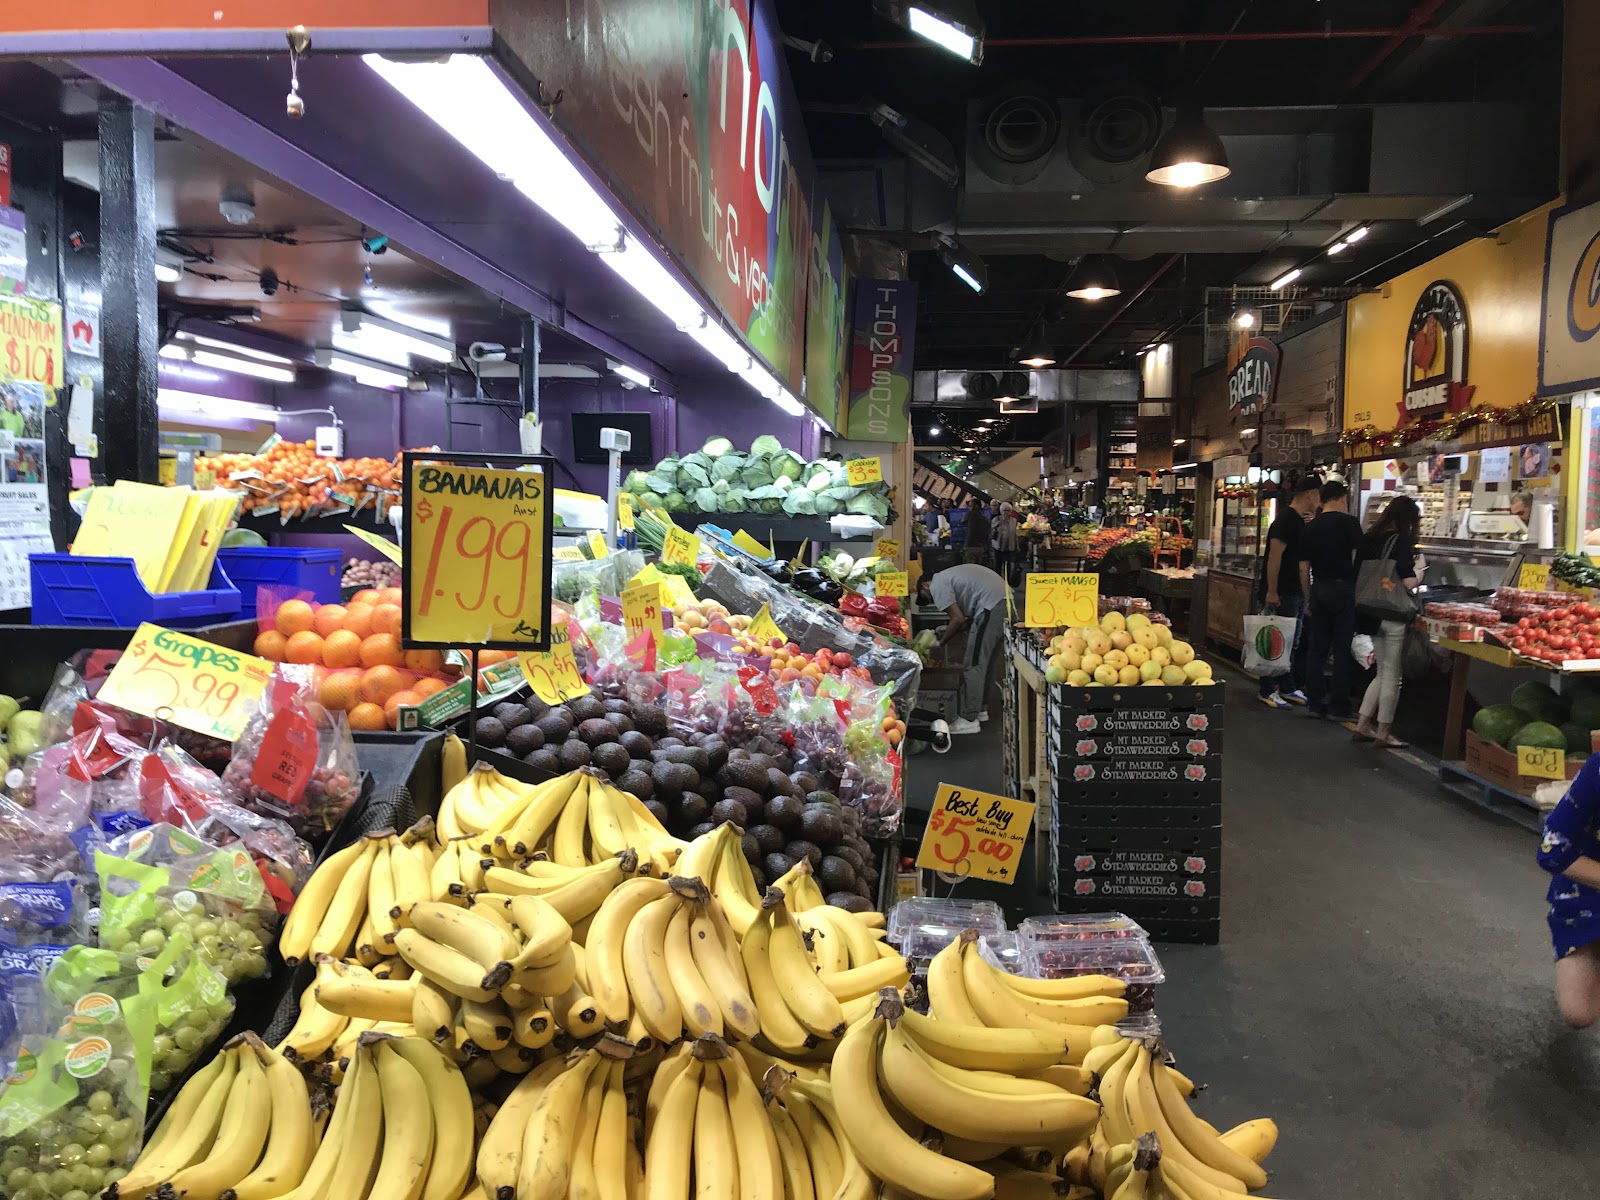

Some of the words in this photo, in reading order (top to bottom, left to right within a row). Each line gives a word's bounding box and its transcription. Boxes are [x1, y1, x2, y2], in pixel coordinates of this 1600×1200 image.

[679, 116, 722, 263] fruit
[868, 287, 898, 435] THOMPSONS
[1229, 358, 1271, 410] BREAD
[1405, 382, 1448, 411] CUISINE
[1266, 432, 1311, 449] STALL
[418, 467, 541, 501] BANANAS
[415, 497, 531, 619] $1.99
[1028, 576, 1058, 586] Sweet
[1060, 576, 1098, 586] MANGO
[1031, 587, 1056, 625] 3
[153, 630, 241, 673] Grapes
[1104, 716, 1180, 730] STRAWBERRIES
[1118, 711, 1129, 720] MT
[1132, 711, 1167, 720] BARKER
[1103, 741, 1180, 755] STRAWBERRIES
[1118, 736, 1129, 745] MT
[1132, 736, 1167, 745] BARKER
[278, 760, 297, 777] RED
[1101, 766, 1178, 780] STRAWBERRIES
[1115, 761, 1126, 770] MT
[1129, 761, 1164, 770] BARKER
[945, 791, 980, 817] Best
[985, 800, 1014, 831] Buy
[1102, 858, 1178, 872] STRAWBERRIES
[1116, 853, 1127, 862] MT
[1129, 853, 1164, 862] BARKER
[1101, 881, 1178, 895] STRAWBERRIES
[1115, 876, 1126, 885] MT
[1129, 876, 1164, 885] BARKER
[7, 893, 66, 912] GRAPES
